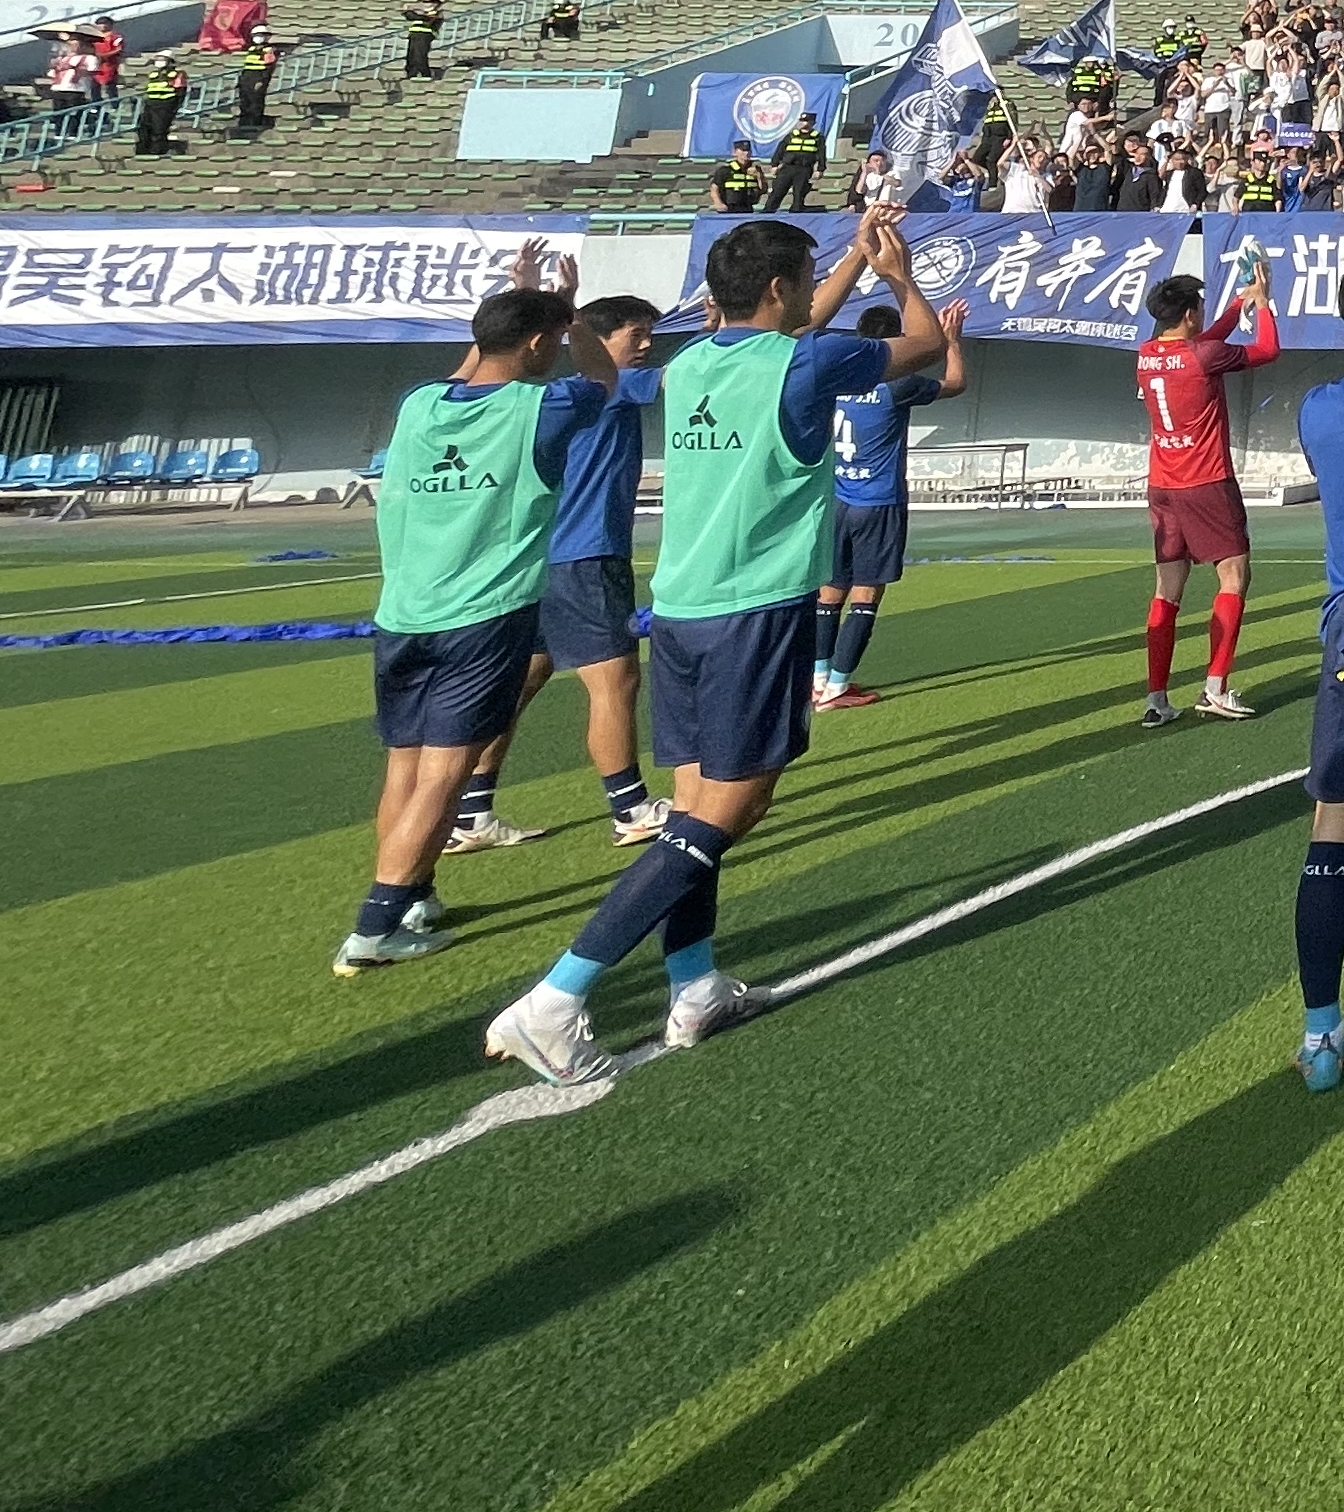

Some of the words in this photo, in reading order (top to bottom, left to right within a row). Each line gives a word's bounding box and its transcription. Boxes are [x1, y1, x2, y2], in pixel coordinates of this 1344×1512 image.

[1149, 377, 1174, 432] 1
[671, 430, 744, 450] OGLLA
[833, 409, 857, 463] 4
[409, 472, 500, 493] OGLLA
